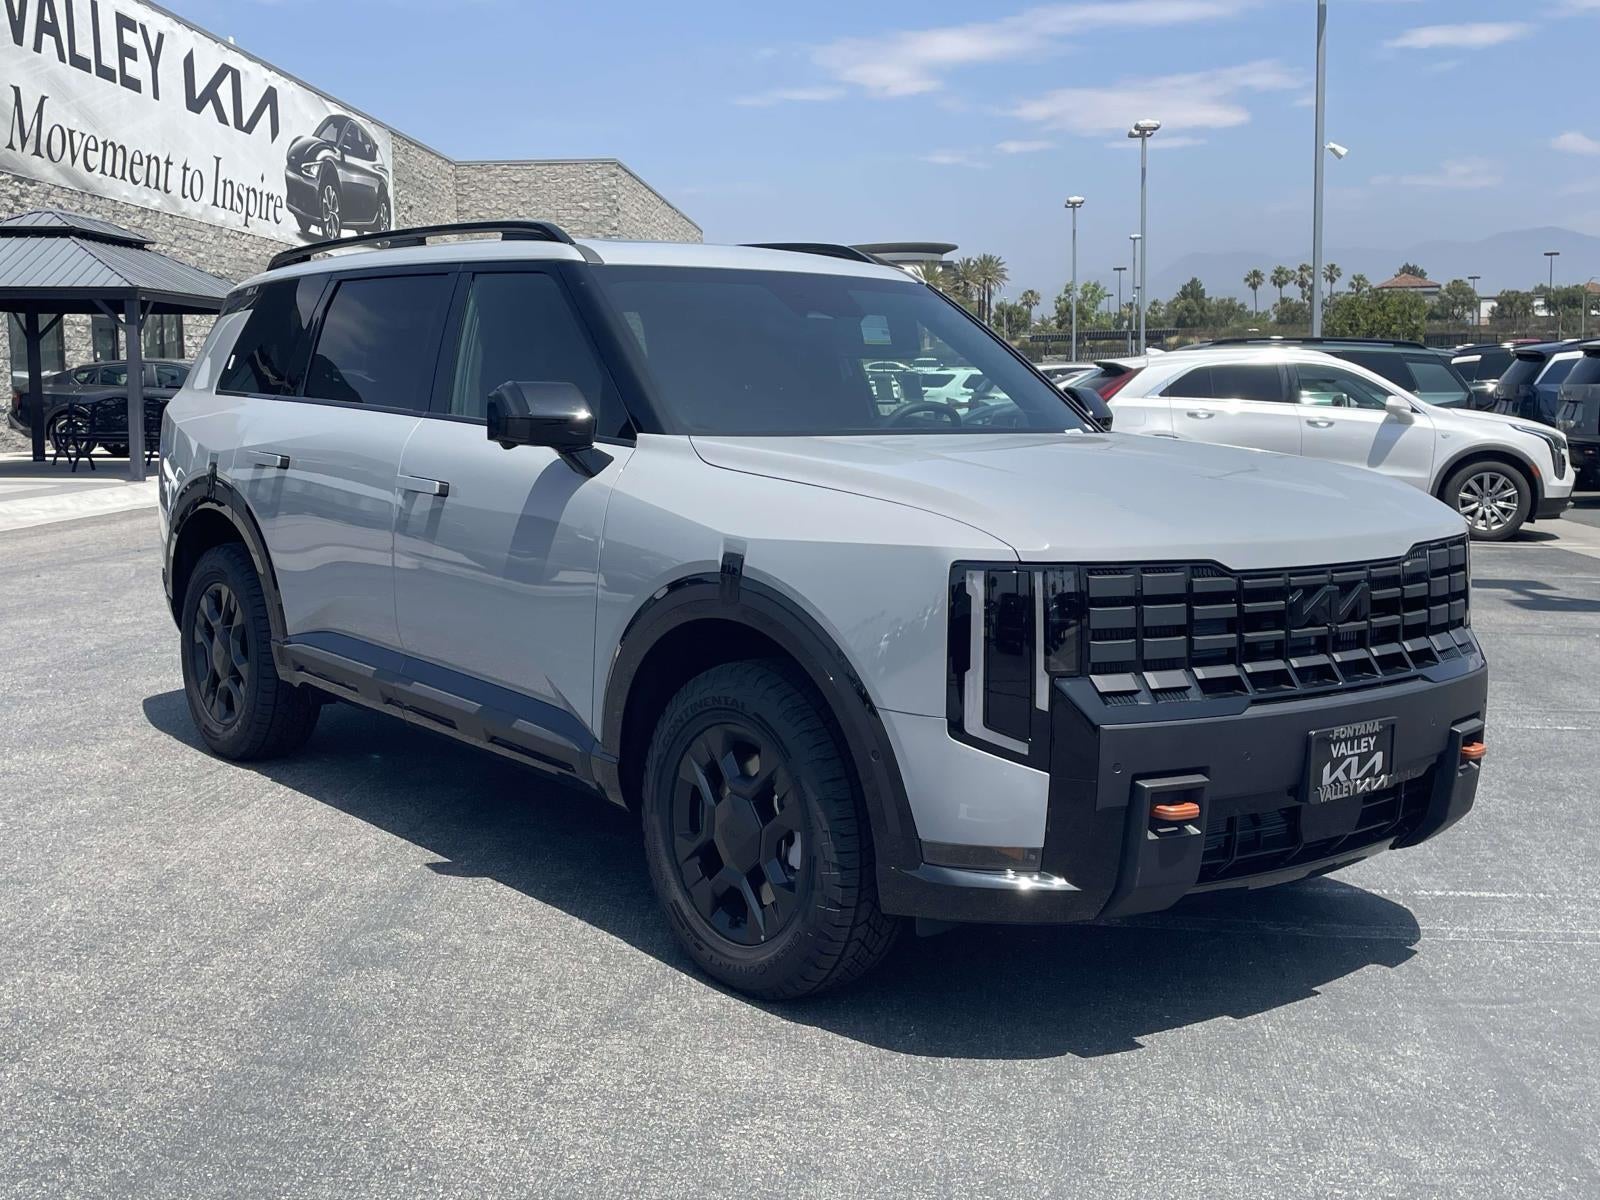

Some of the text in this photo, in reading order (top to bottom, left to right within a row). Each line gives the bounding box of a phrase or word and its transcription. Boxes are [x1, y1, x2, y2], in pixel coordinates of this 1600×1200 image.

[4, 0, 164, 101] VALLEY
[5, 84, 283, 227] Movement to Inspire
[1331, 736, 1376, 758] VALLEY
[1318, 782, 1356, 803] VALLEY
